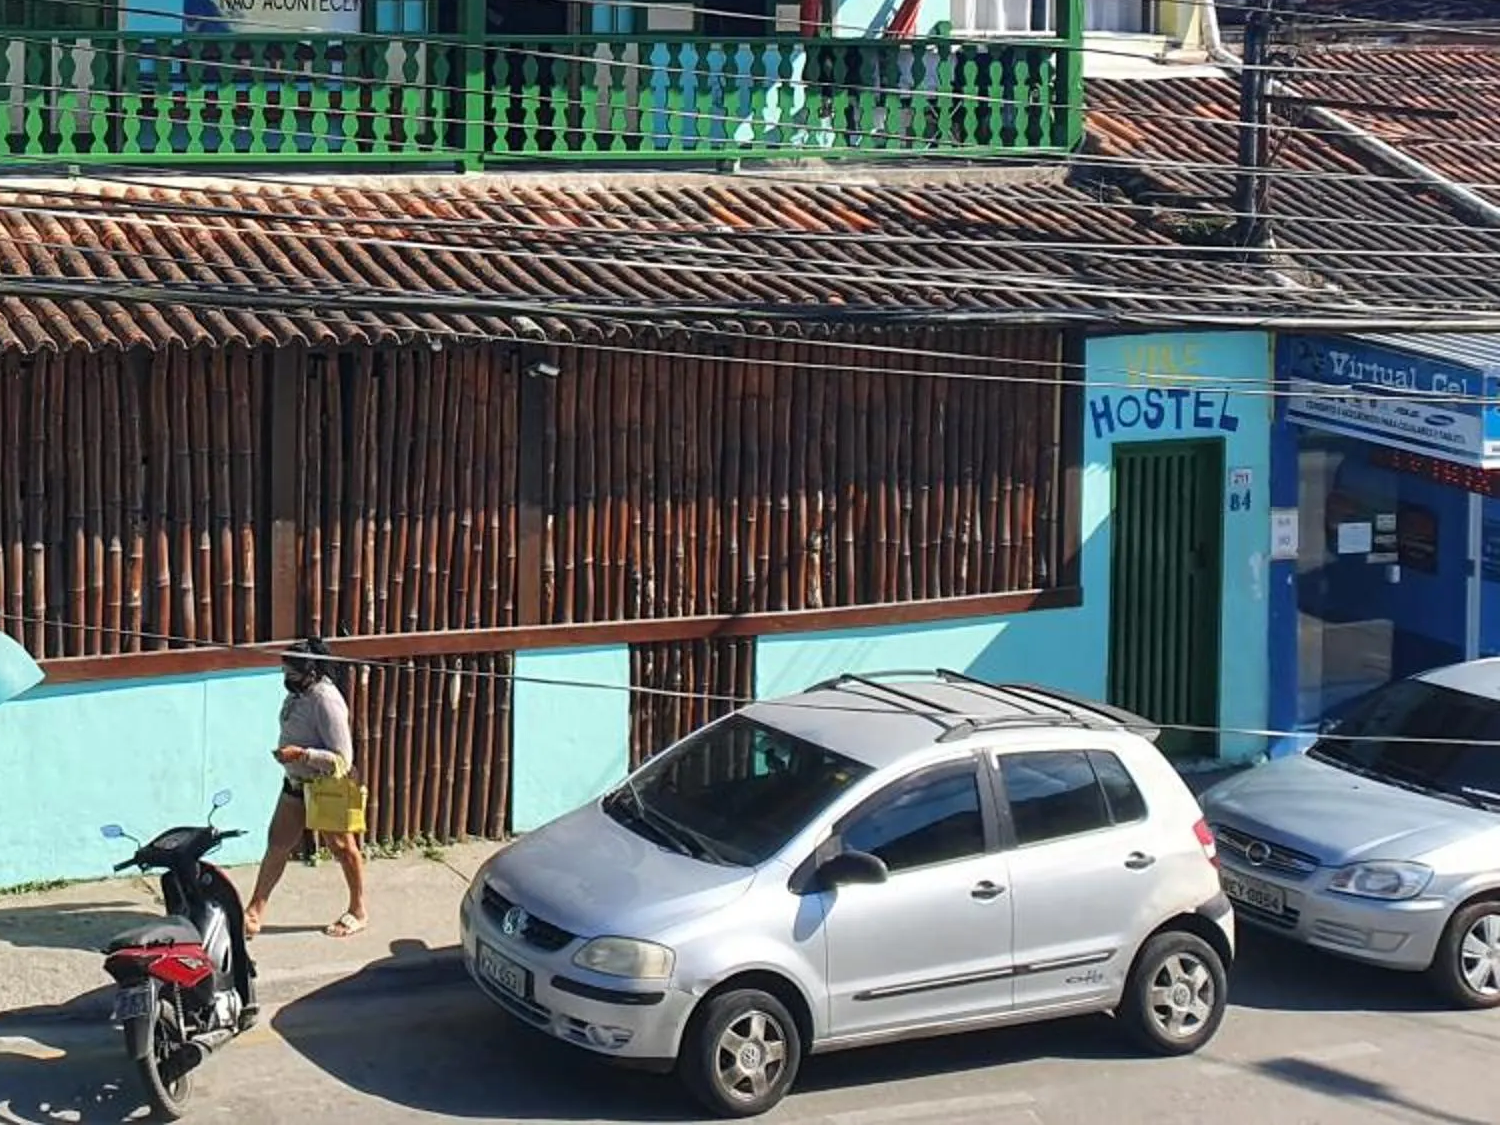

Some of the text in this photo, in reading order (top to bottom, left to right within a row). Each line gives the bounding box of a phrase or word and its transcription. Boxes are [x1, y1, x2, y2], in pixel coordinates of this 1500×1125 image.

[1329, 349, 1468, 396] Virtual Cel
[1089, 387, 1239, 438] HOSTEL
